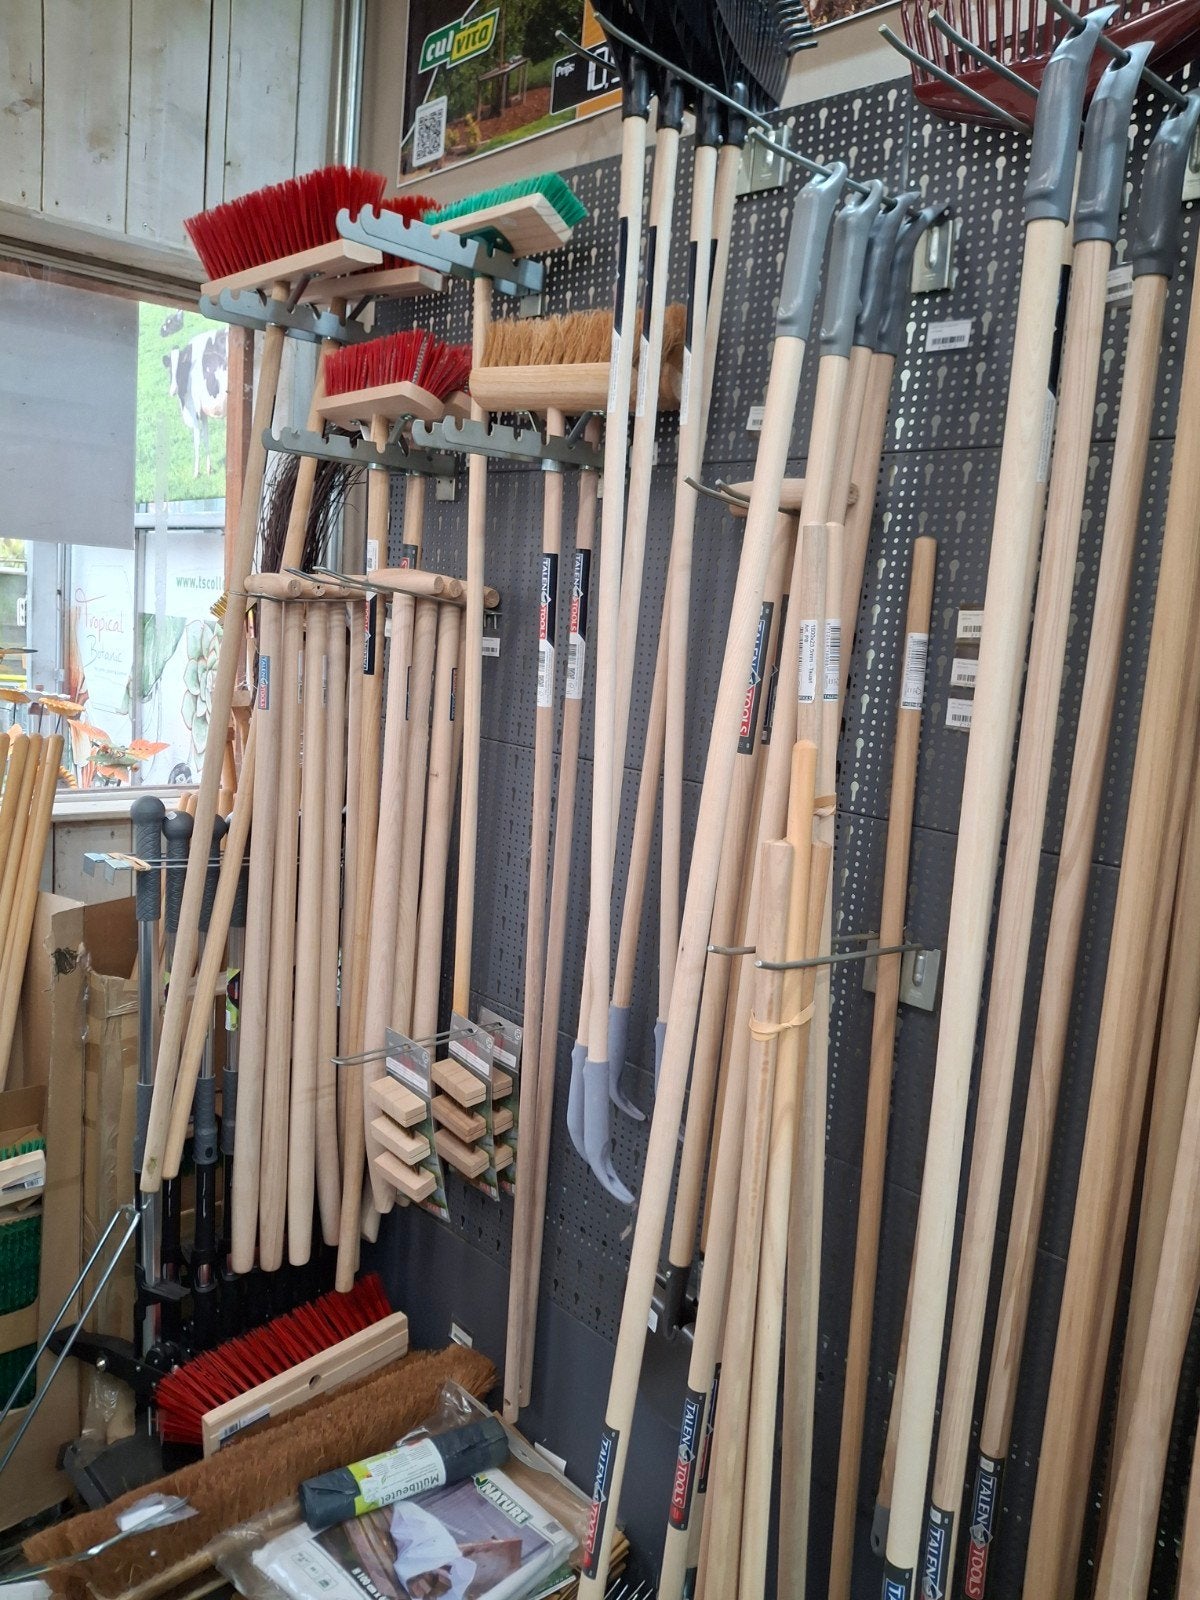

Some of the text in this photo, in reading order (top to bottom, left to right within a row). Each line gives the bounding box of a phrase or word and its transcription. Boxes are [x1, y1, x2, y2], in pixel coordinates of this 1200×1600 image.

[75, 588, 124, 642] Tropical
[84, 635, 124, 668] Botanic
[682, 1402, 696, 1446] TALEN
[594, 1438, 610, 1486] TALEN
[380, 1473, 440, 1505] Müllbeutel
[481, 1482, 529, 1524] NATURE
[672, 1465, 688, 1507] TOOLS
[976, 1477, 993, 1526] TALEN
[584, 1503, 599, 1553] TOOLS
[925, 1528, 941, 1578] TALEN
[968, 1548, 986, 1595] TOOLS
